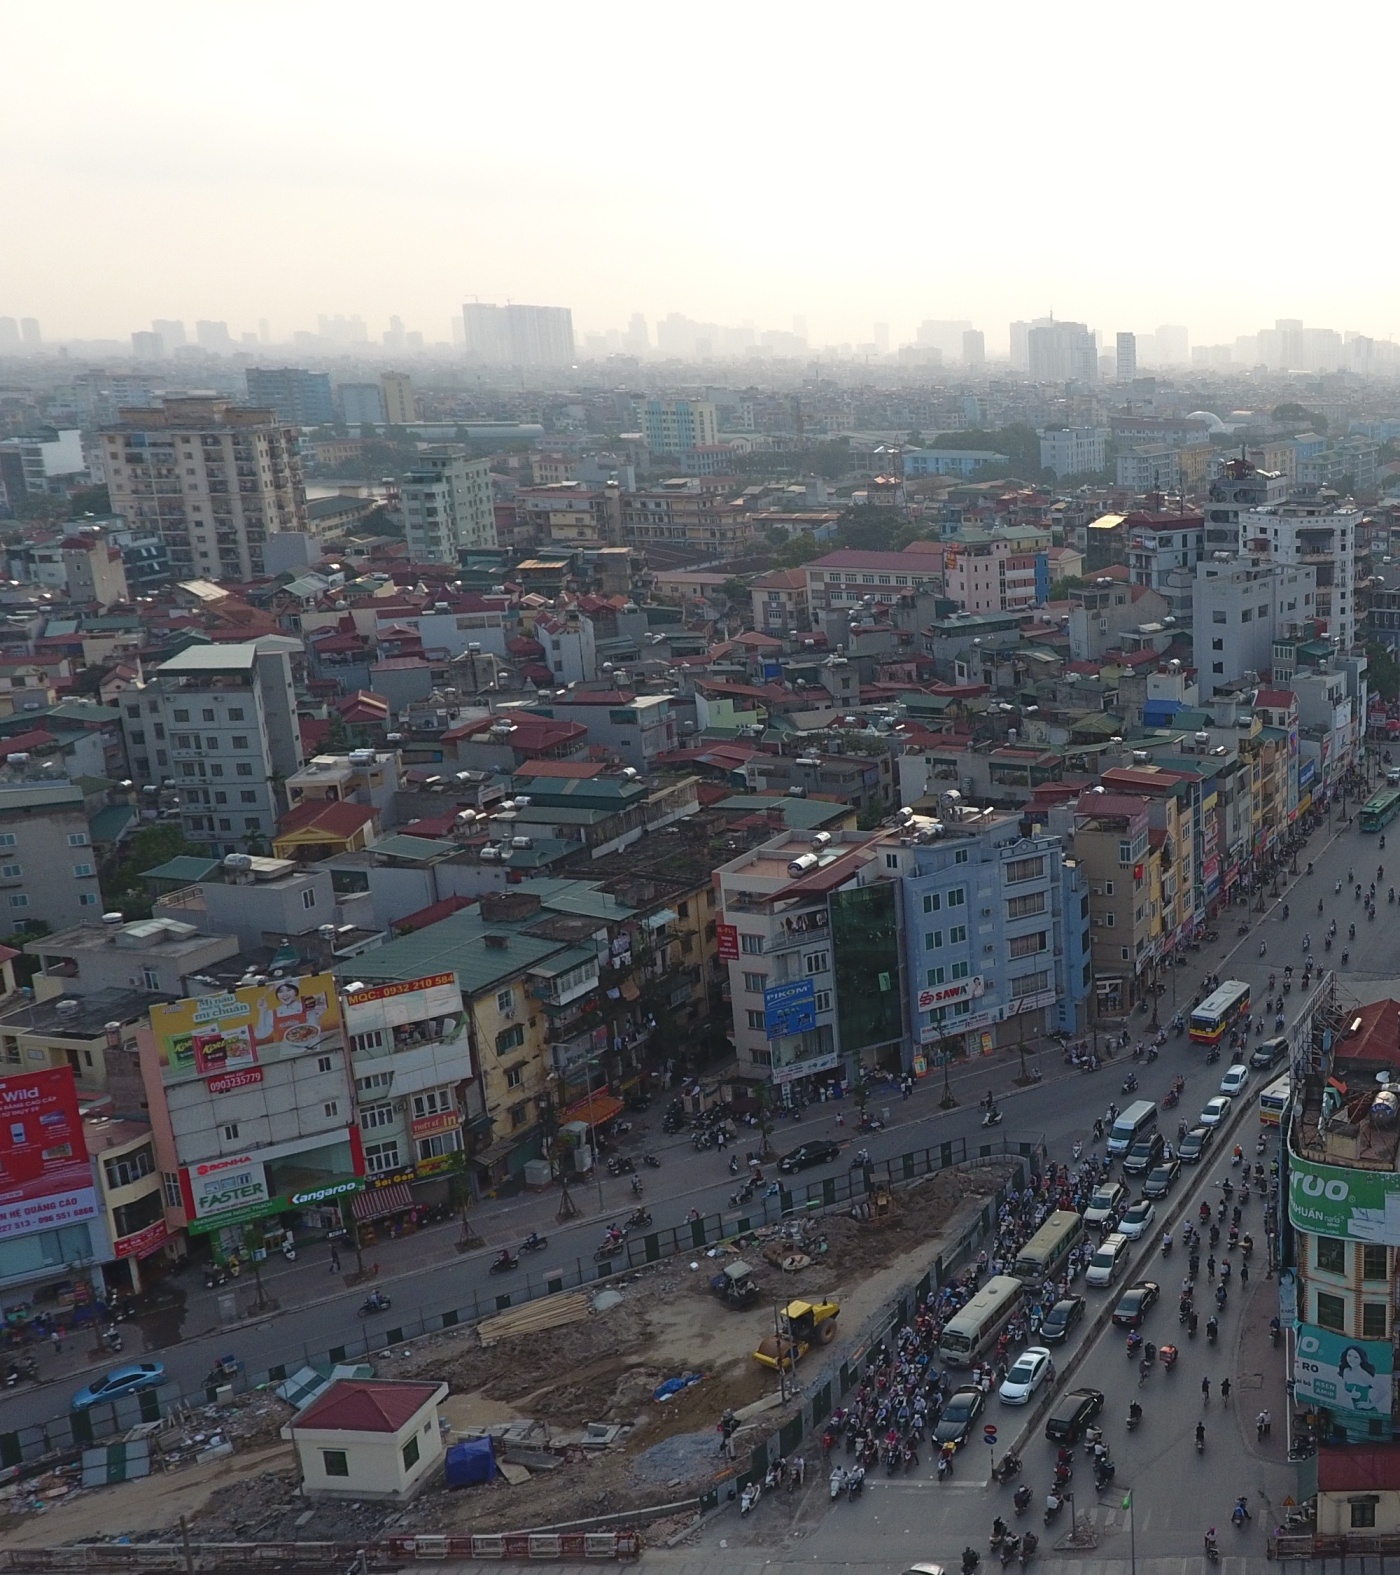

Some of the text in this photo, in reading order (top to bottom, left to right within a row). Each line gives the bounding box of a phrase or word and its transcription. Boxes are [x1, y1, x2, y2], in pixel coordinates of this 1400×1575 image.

[348, 974, 454, 1004] MQC: 0932 210 584
[766, 986, 808, 1001] PIKOM
[935, 986, 967, 1001] SAWA
[210, 1072, 261, 1091] 0903235779
[3, 1087, 39, 1102] Wild
[290, 1182, 356, 1204] Kangaroo
[1290, 1170, 1349, 1201] roo
[199, 1183, 264, 1208] FASTER
[14, 1220, 31, 1229] 513
[56, 1211, 71, 1220] 551
[1302, 1362, 1319, 1373] RO
